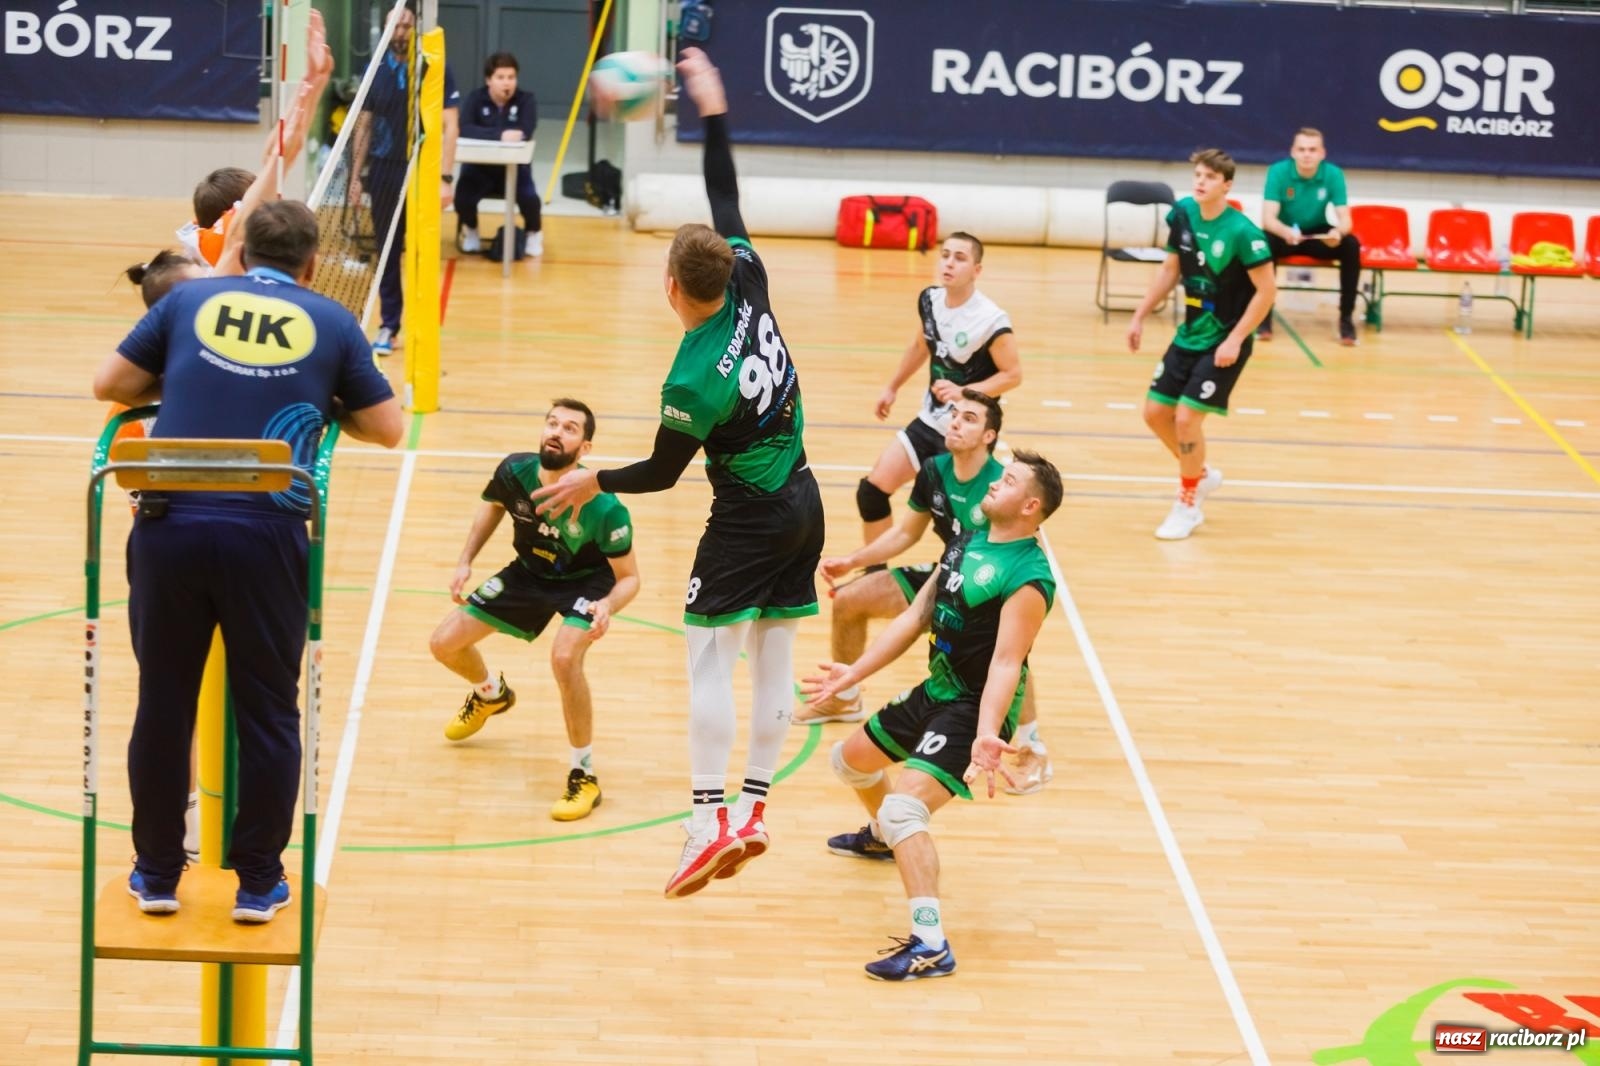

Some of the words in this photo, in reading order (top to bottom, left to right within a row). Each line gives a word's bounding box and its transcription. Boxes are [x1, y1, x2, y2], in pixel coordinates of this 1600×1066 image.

[5, 0, 173, 61] BÓRZ
[931, 41, 1244, 106] RACIBÓRZ
[1379, 48, 1556, 116] OSiR
[1446, 114, 1555, 138] RACIBÓRZ
[214, 304, 296, 350] HK
[716, 354, 734, 379] KS
[738, 312, 787, 416] 98
[1199, 380, 1217, 399] 9
[945, 571, 965, 593] 10
[915, 731, 948, 755] 10
